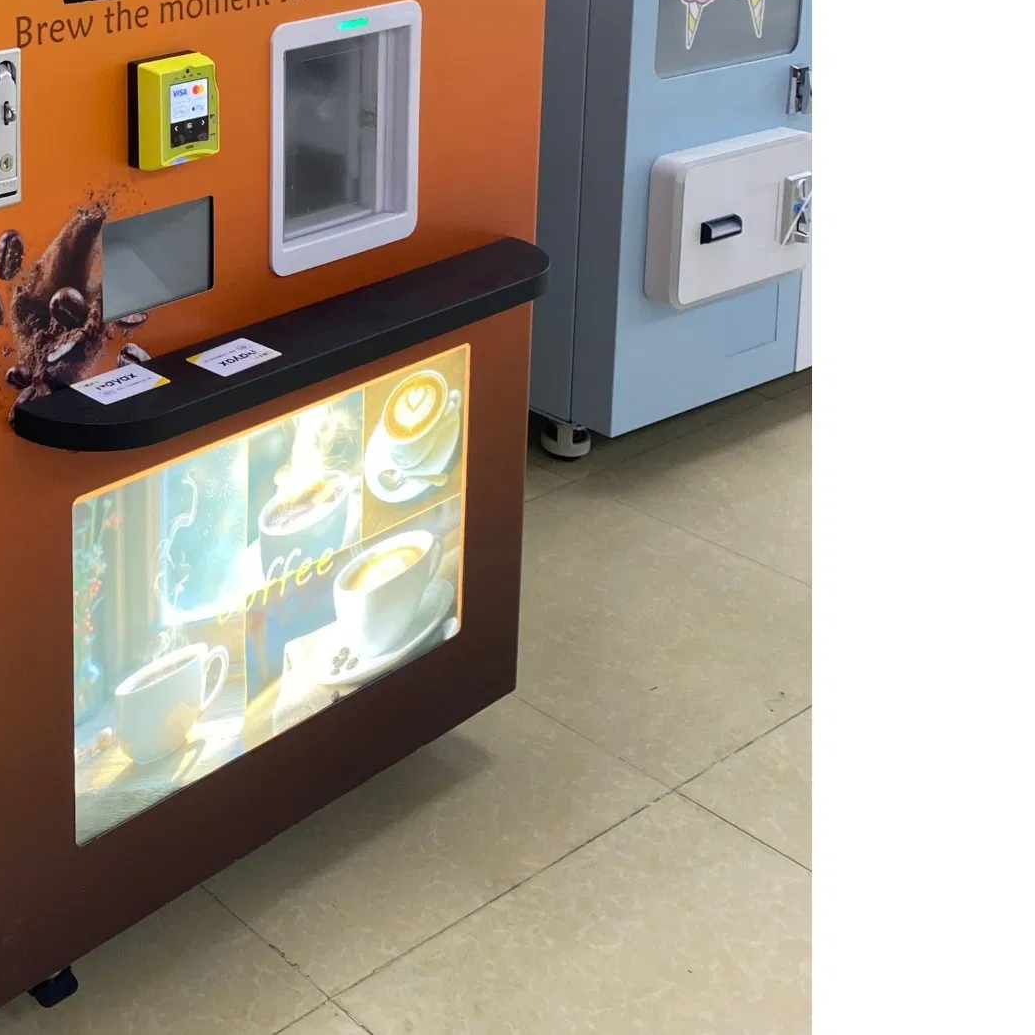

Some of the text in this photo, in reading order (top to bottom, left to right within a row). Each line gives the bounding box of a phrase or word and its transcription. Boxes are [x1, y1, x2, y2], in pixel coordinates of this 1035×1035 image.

[15, 15, 94, 49] Brew
[103, 0, 150, 34] the
[172, 88, 188, 98] VISA
